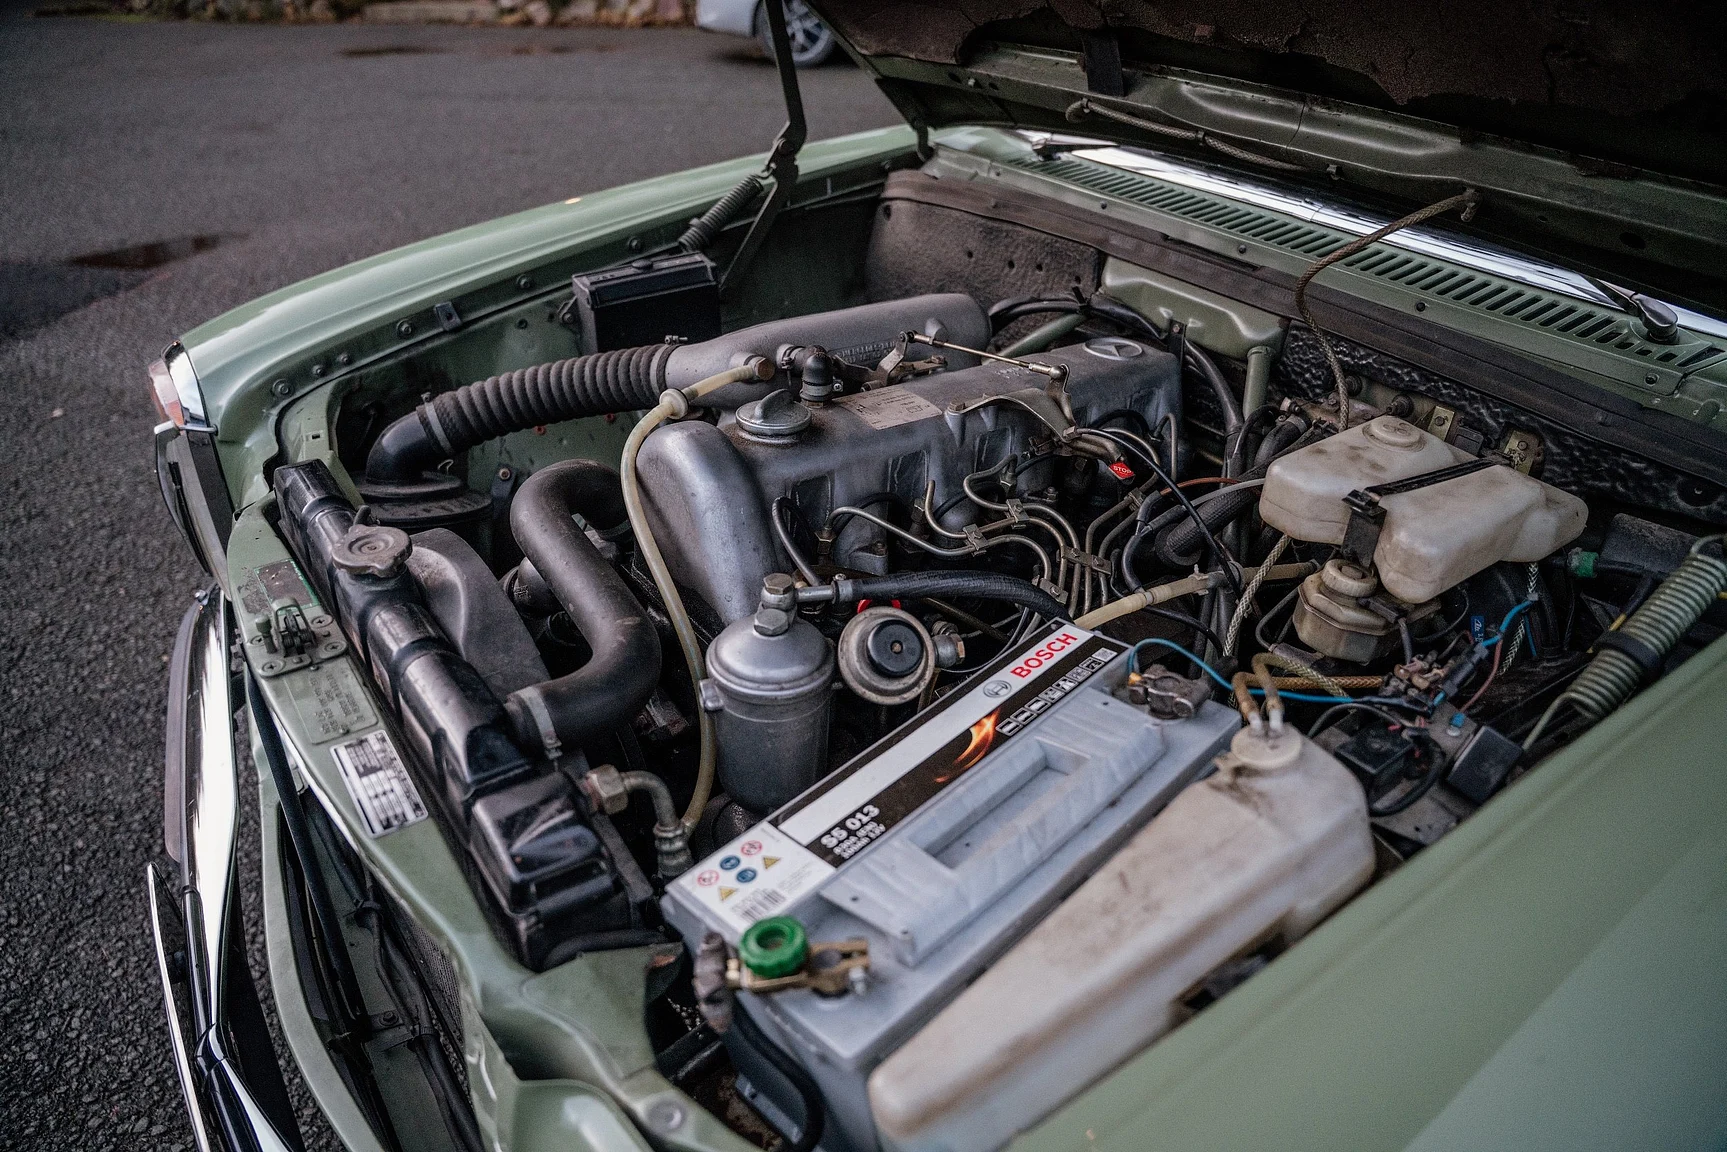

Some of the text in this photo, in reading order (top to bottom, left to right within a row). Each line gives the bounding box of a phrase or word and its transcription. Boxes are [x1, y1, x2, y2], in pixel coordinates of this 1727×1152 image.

[1010, 633, 1078, 678] BOSCH
[820, 827, 848, 848] S5
[845, 804, 880, 830] 013
